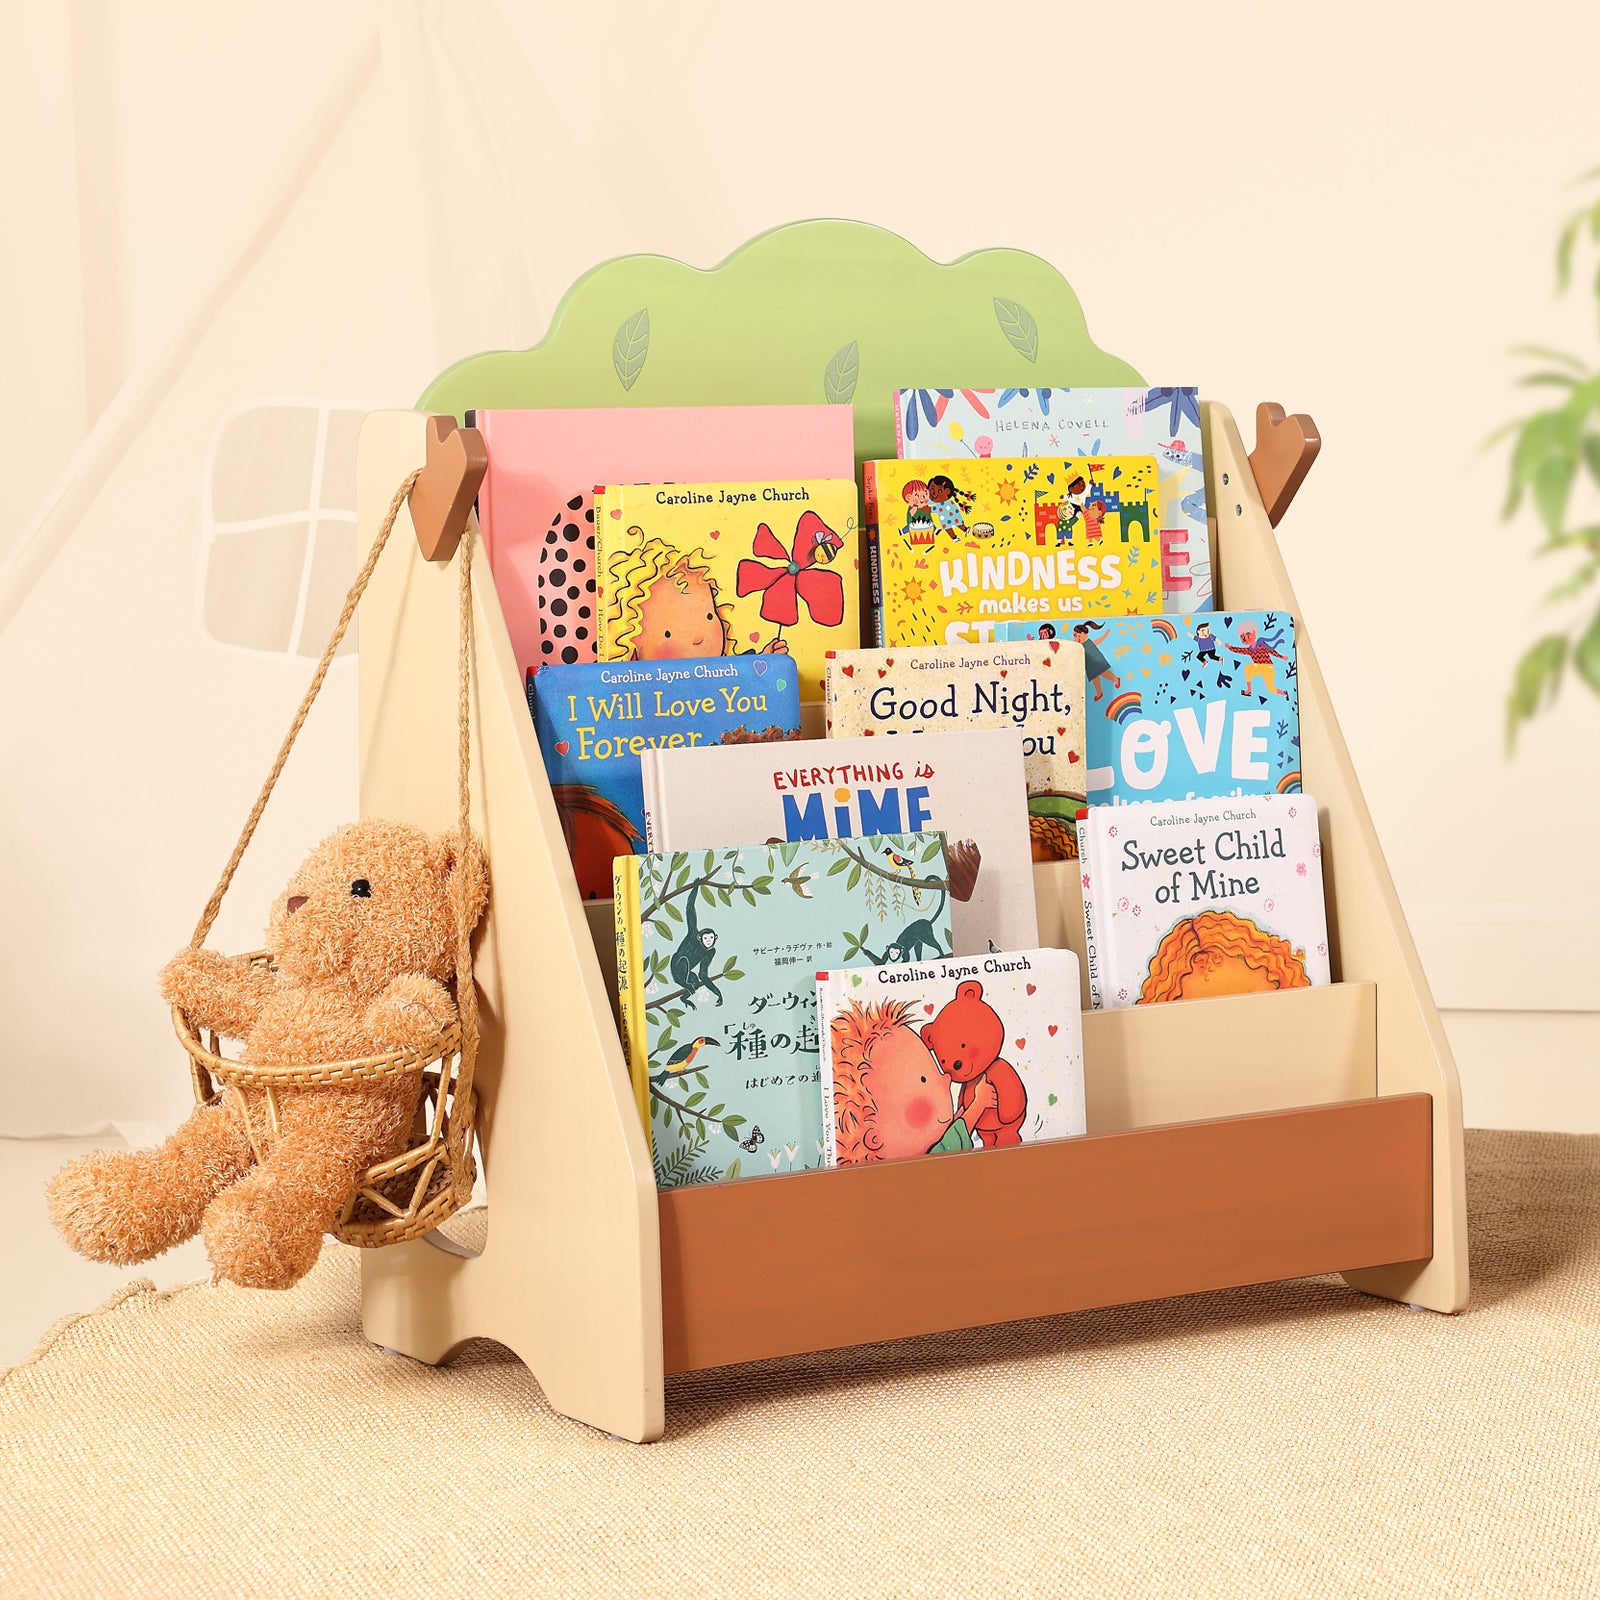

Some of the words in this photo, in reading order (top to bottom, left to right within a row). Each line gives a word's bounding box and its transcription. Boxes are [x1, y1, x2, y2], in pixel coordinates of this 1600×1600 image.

[995, 419, 1050, 432] HELENA
[1058, 418, 1109, 430] COVELL
[656, 490, 713, 505] Caroline
[718, 490, 757, 505] Jayne
[762, 487, 810, 502] Church
[869, 545, 880, 604] KINDNESS
[939, 549, 1122, 597] KINDNESS
[979, 592, 1051, 614] makes
[1058, 596, 1083, 612] us
[600, 669, 653, 684] Caroline
[655, 668, 691, 682] Jayne
[694, 664, 738, 678] Church
[910, 658, 956, 670] Caroline
[959, 657, 989, 669] Jayne
[992, 654, 1031, 667] Church
[567, 695, 578, 722] I
[586, 692, 643, 722] Will
[654, 690, 716, 717] Love
[719, 686, 768, 713] You
[870, 683, 959, 720] Good
[971, 679, 1072, 722] Night,
[576, 726, 703, 761] Forever
[1022, 734, 1056, 757] ou
[773, 762, 904, 790] EVERYTHING
[914, 761, 935, 779] is
[1150, 816, 1190, 827] Caroline
[1193, 814, 1220, 826] Jayne
[1222, 809, 1257, 821] Church
[1078, 827, 1087, 864] Church
[1121, 838, 1206, 872] Sweet
[1214, 828, 1286, 861] Child
[1155, 871, 1182, 904] of
[1189, 870, 1260, 901] Mine
[1084, 900, 1094, 941] Sweet
[878, 969, 936, 984] Caroline
[940, 965, 979, 980] Jayne
[983, 957, 1032, 973] Church
[1089, 945, 1098, 979] Child
[1091, 983, 1100, 999] of
